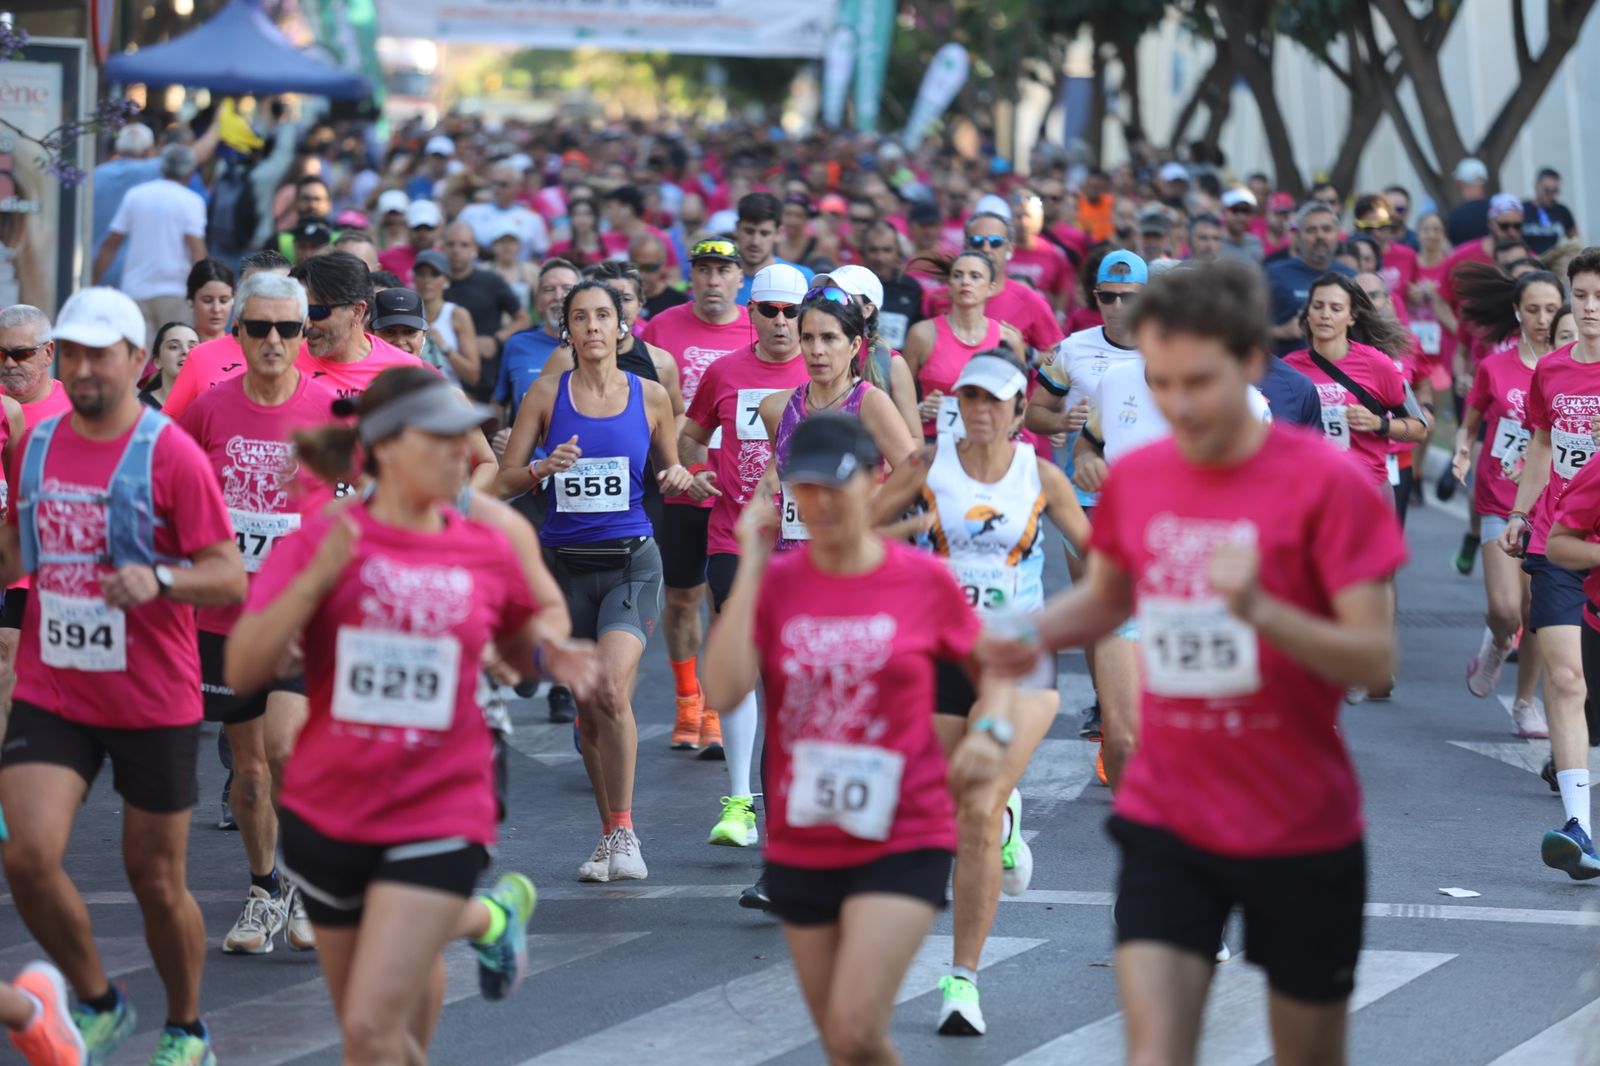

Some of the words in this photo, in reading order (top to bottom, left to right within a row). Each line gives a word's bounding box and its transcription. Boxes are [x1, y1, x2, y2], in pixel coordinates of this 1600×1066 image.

[1556, 444, 1597, 469] 72
[564, 475, 622, 497] 558
[785, 501, 804, 523] 5
[48, 618, 114, 650] 594
[1154, 630, 1239, 671] 125
[349, 663, 439, 701] 629
[815, 772, 869, 812] 50
